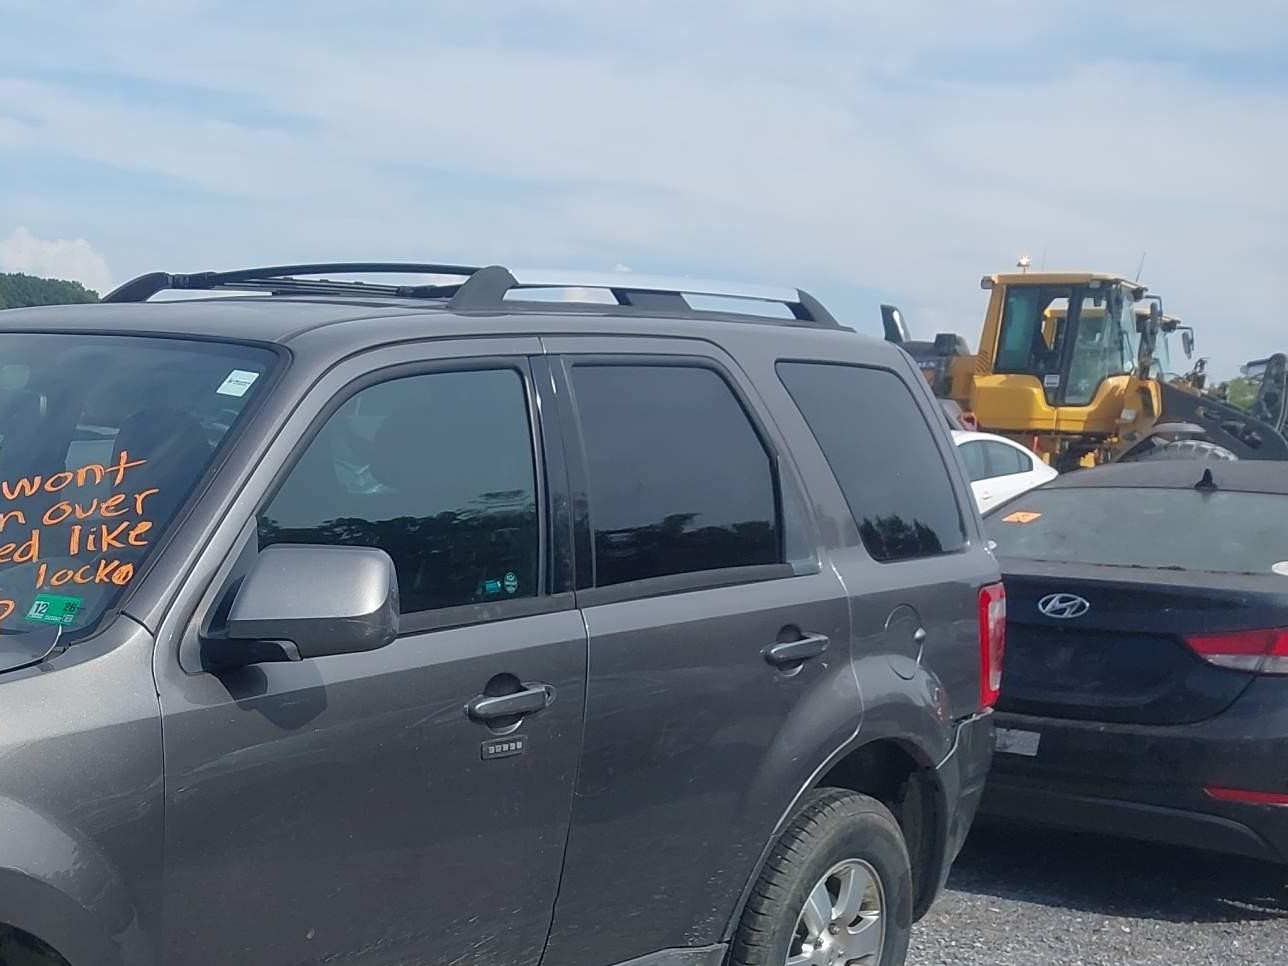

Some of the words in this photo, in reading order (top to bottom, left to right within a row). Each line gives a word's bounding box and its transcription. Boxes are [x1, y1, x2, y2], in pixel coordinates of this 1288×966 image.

[1, 450, 148, 501] wont
[42, 488, 160, 526] over
[33, 602, 49, 614] 12
